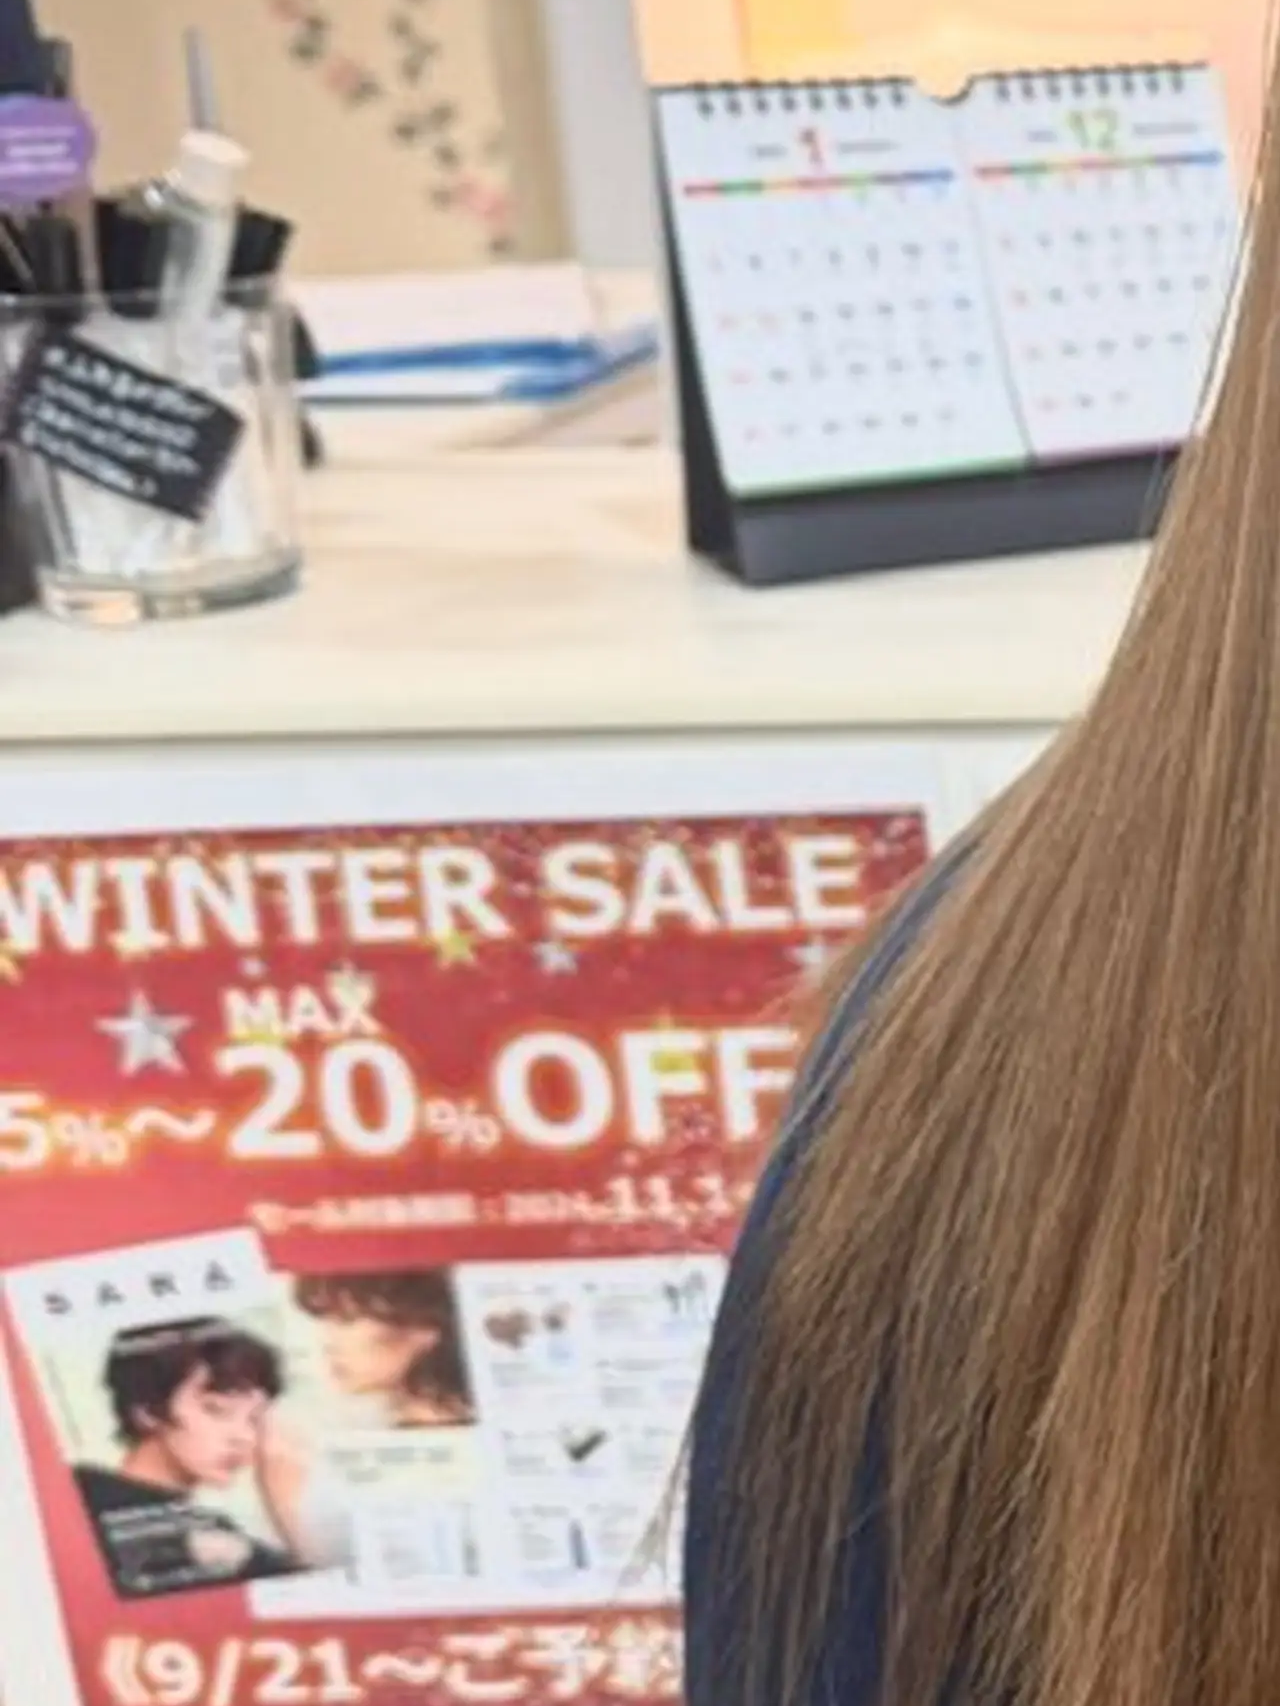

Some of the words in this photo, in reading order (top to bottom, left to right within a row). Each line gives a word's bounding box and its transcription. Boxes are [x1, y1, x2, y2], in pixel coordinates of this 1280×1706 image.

[0, 846, 514, 953] WINTER
[538, 833, 867, 939] SALE
[225, 987, 383, 1037] MAX
[44, 1259, 233, 1315] SARA
